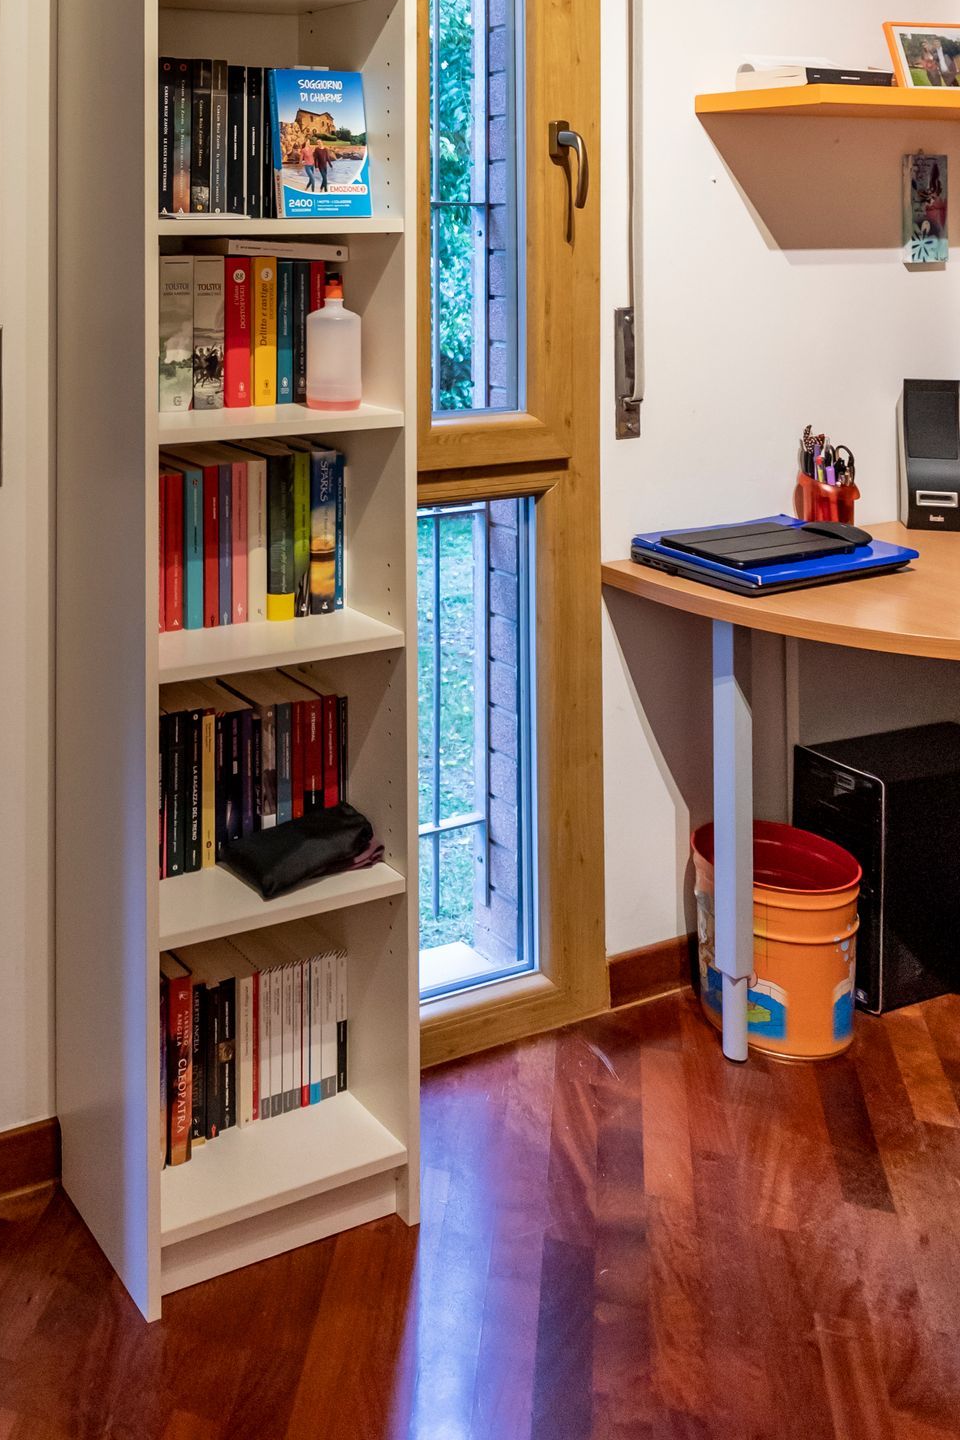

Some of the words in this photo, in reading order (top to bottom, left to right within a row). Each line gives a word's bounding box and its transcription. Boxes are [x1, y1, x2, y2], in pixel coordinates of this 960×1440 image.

[297, 79, 343, 90] SOGGIORNO
[300, 92, 308, 103] DI
[310, 92, 344, 103] CHARME
[288, 199, 313, 208] 2400
[259, 282, 269, 311] castigo
[259, 318, 269, 346] Delitto
[320, 460, 329, 502] SPARKS
[192, 765, 198, 774] LA
[176, 1057, 188, 1135] CLEOPATRA
